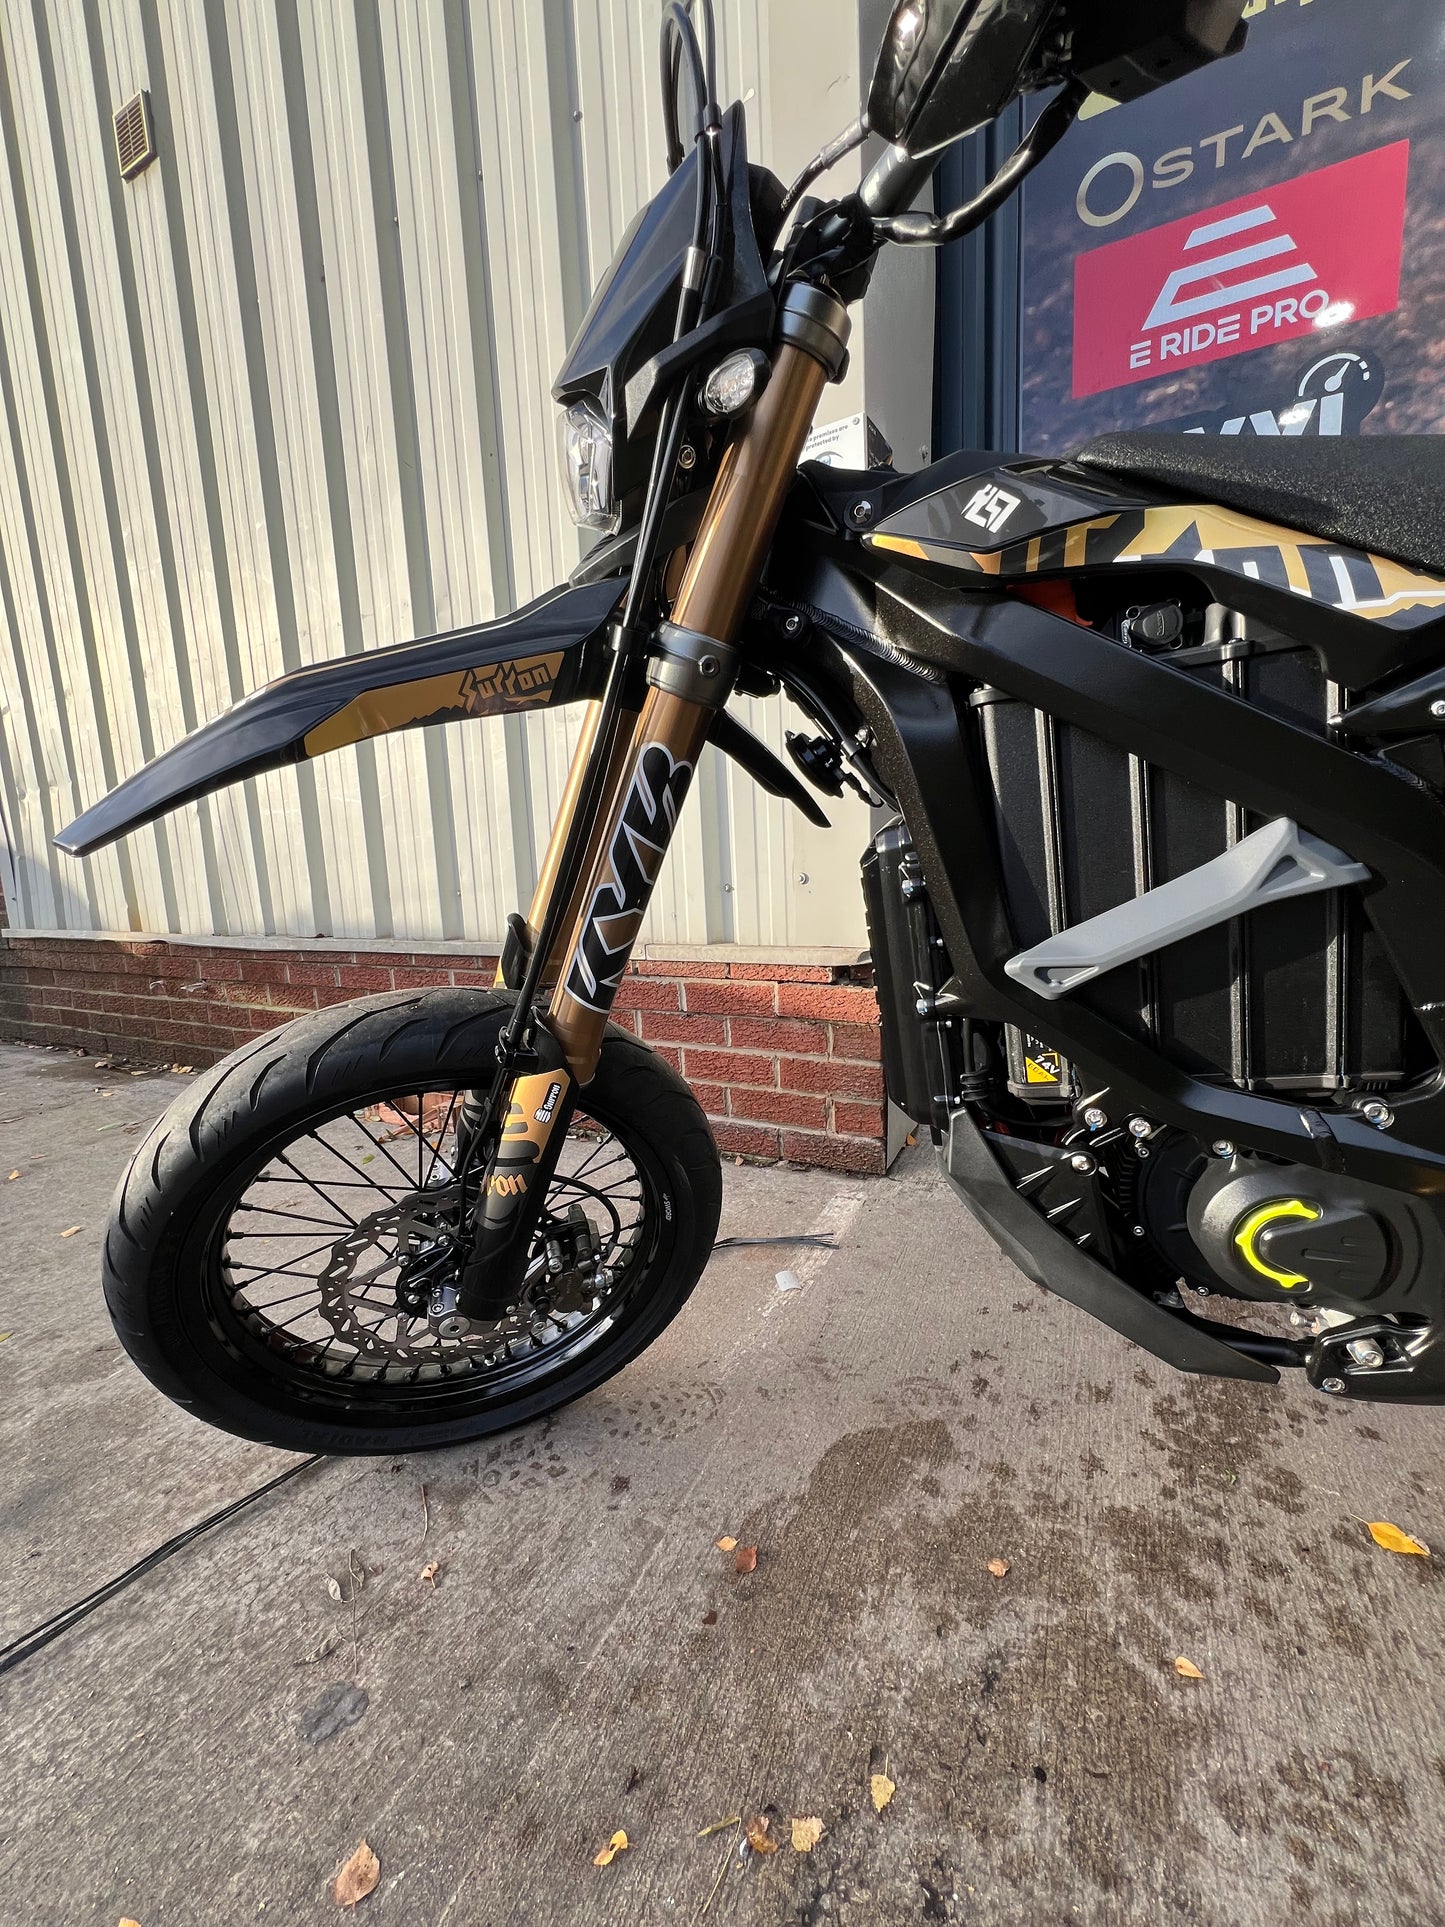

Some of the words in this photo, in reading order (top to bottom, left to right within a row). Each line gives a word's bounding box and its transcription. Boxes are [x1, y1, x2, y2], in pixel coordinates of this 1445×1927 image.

[1129, 340, 1151, 369] E
[1160, 313, 1241, 360] RIDE
[1250, 289, 1330, 335] PRO
[813, 427, 838, 442] premises
[838, 424, 849, 433] are
[805, 436, 832, 452] protected
[832, 434, 840, 442] by
[1034, 1054, 1060, 1074] 74V
